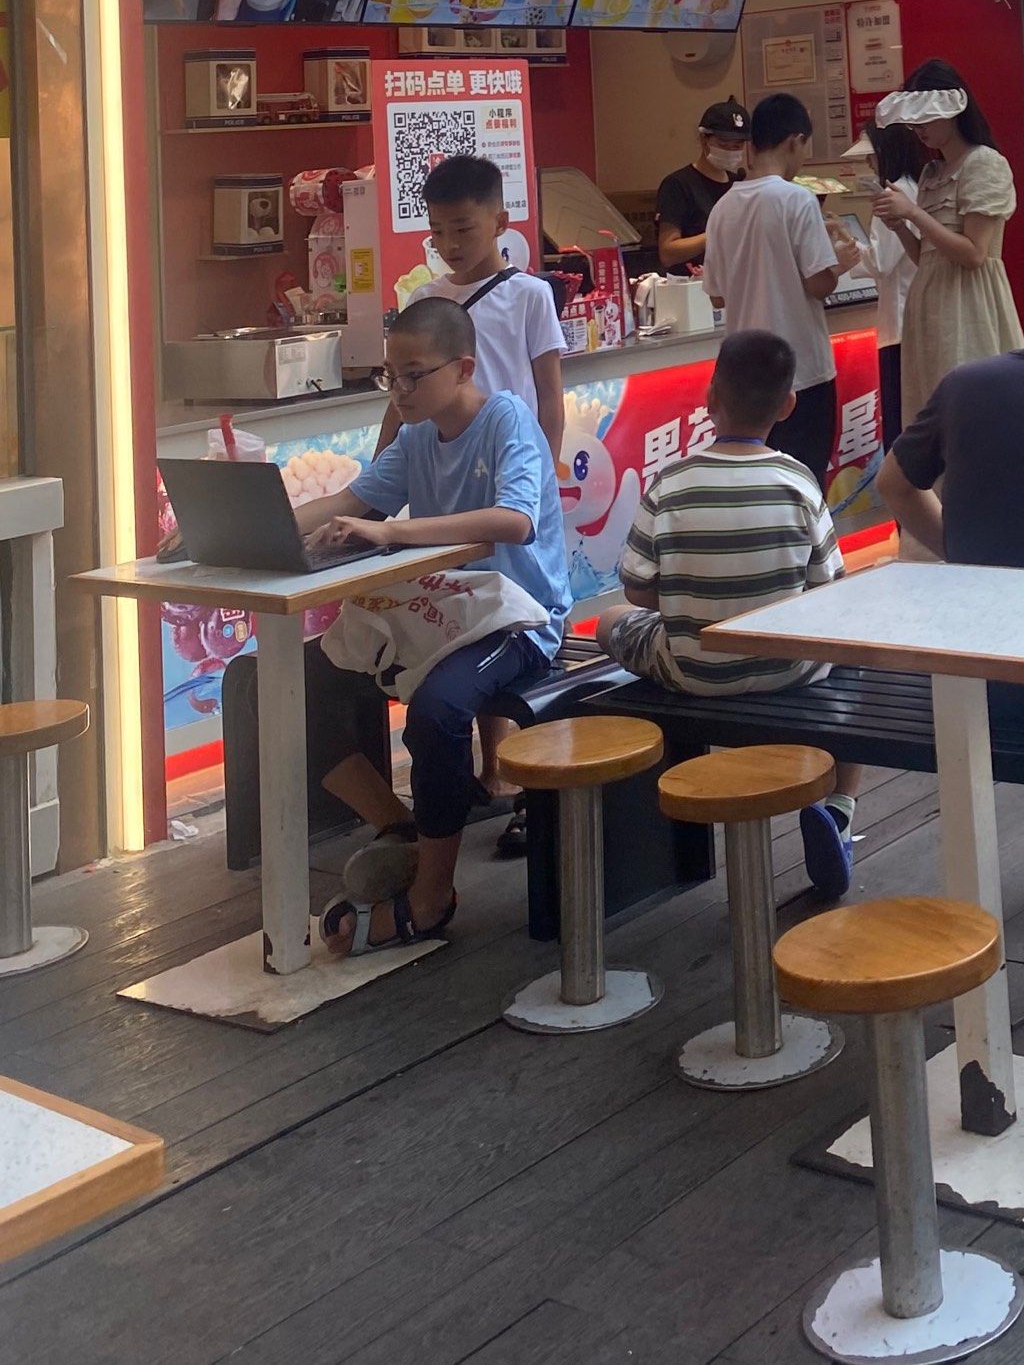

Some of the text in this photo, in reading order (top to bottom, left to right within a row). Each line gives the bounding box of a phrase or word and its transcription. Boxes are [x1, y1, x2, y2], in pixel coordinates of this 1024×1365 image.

[384, 68, 523, 97] 扫码点单 更快哦
